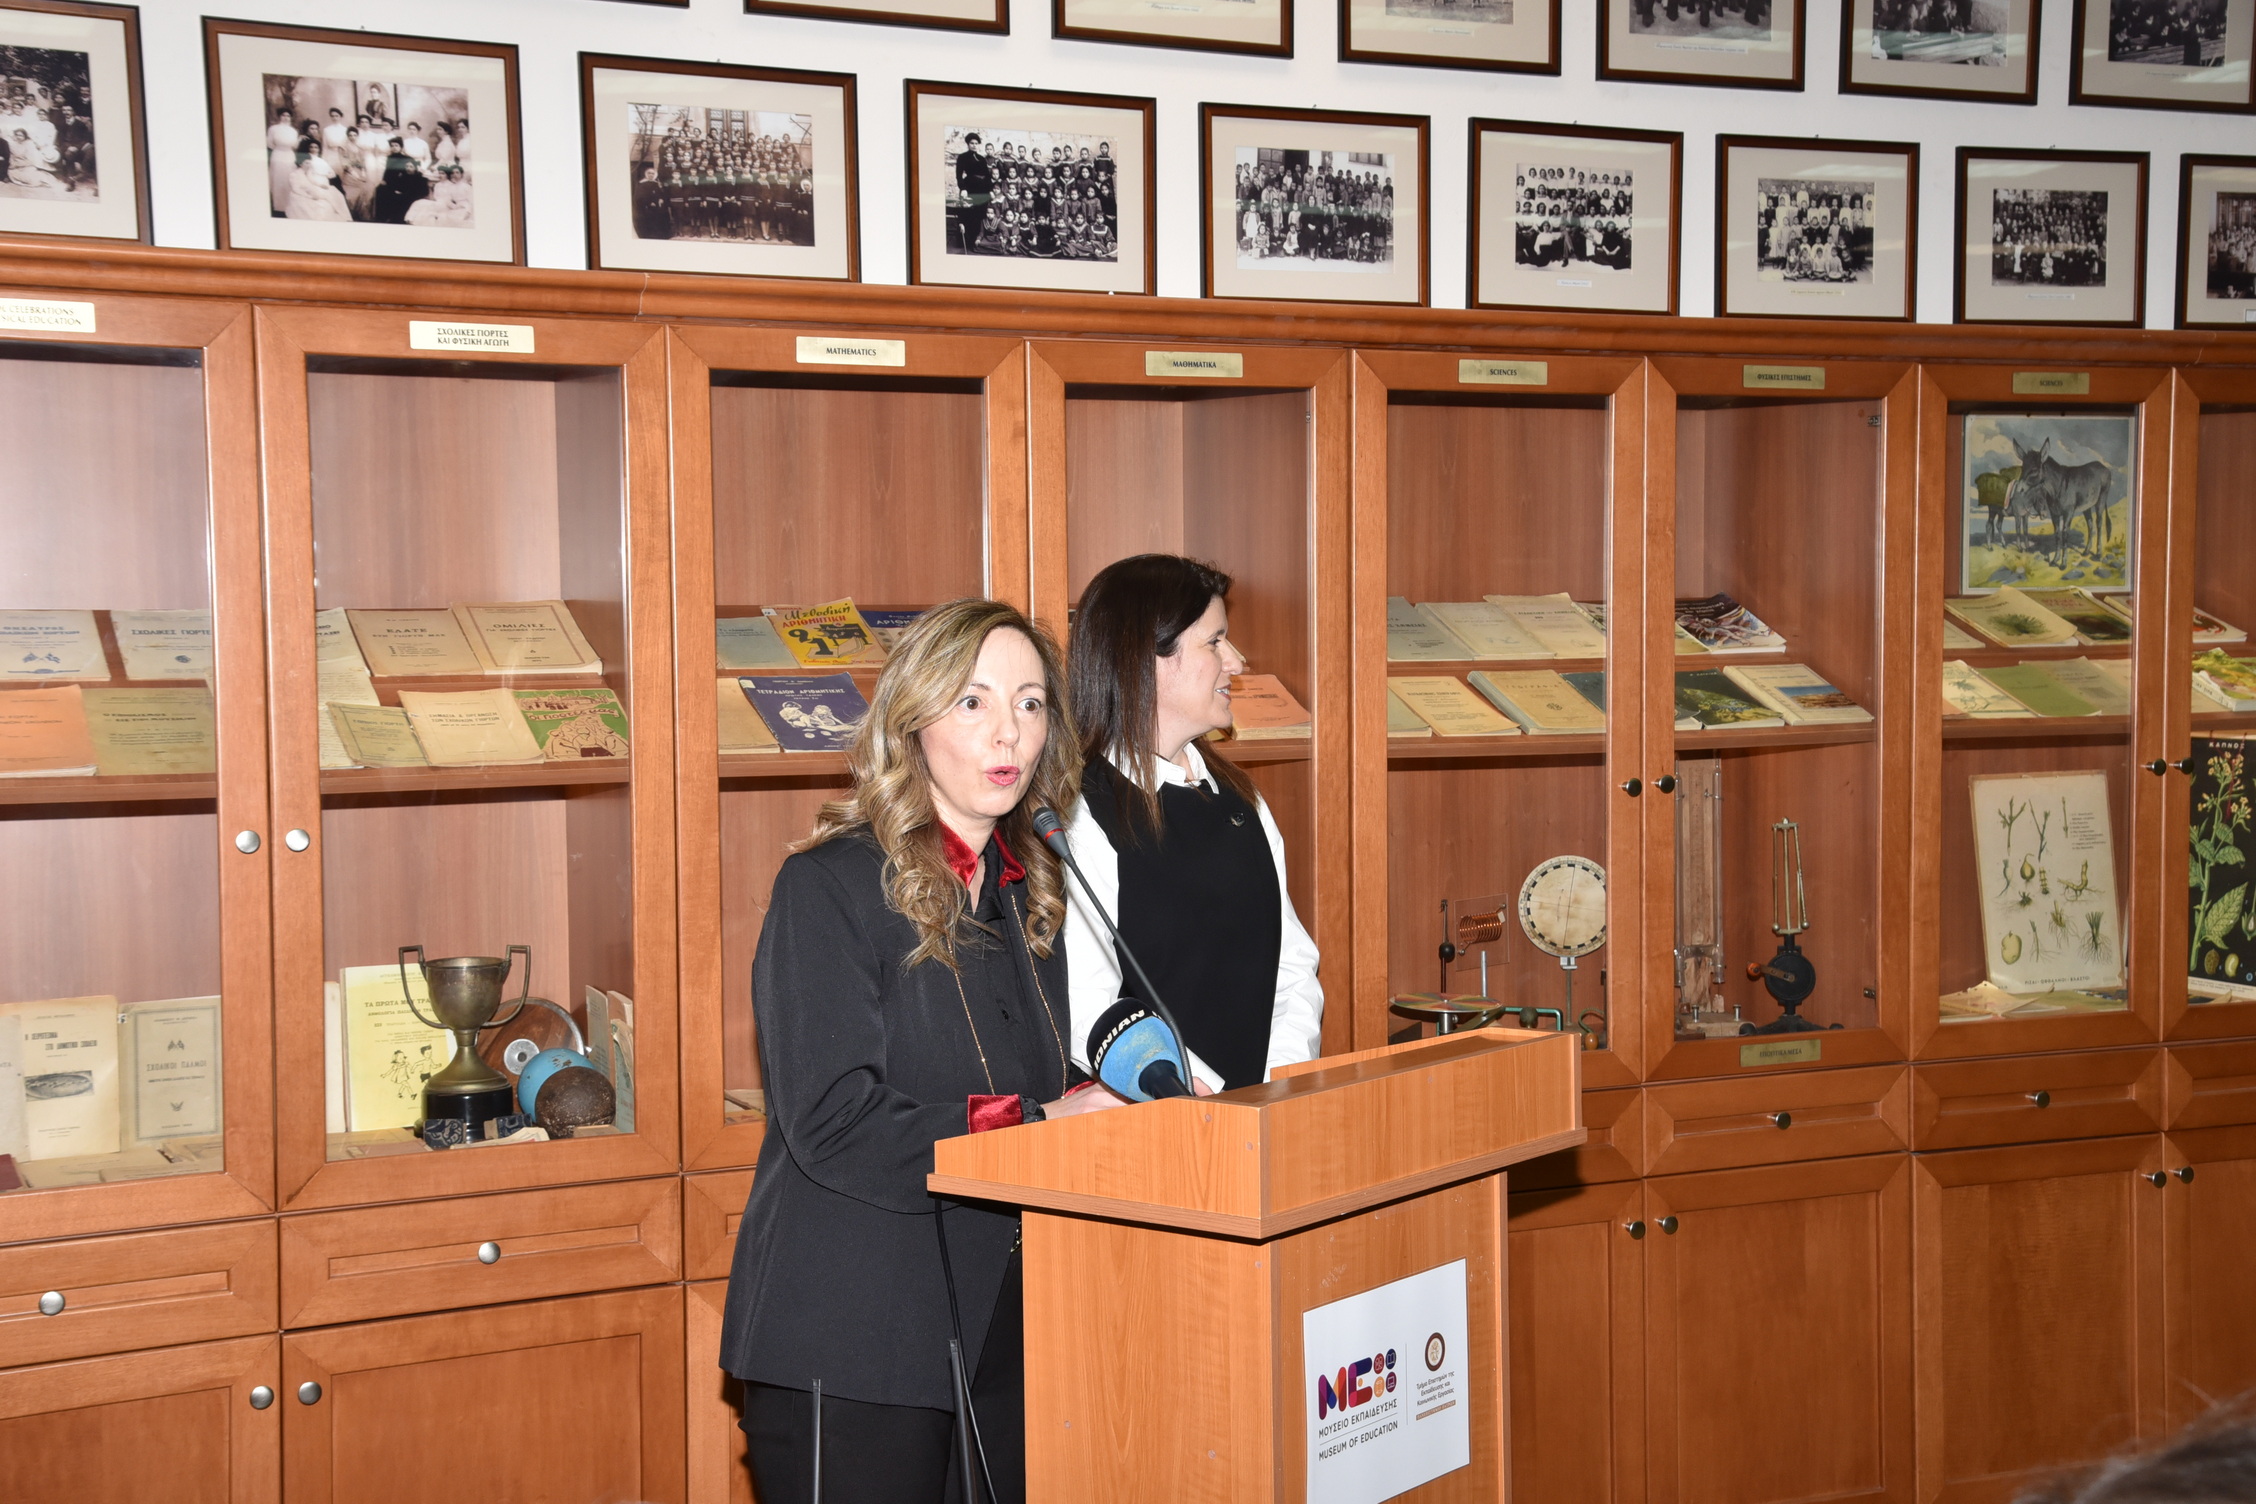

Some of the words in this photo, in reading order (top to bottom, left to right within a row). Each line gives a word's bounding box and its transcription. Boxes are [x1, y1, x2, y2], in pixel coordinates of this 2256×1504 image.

[9, 305, 75, 316] CELEBRATIONS
[29, 315, 82, 326] EDUCATION
[437, 327, 476, 337] ΣΧΟΛΙΚΕΣ
[477, 329, 509, 338] ΓΙΟΡΤΕΣ
[437, 336, 451, 344] ΚΑΙ
[451, 337, 482, 346] ΦΥΣΙΚΗ
[483, 338, 510, 347] ΑΓΩΓΗ
[826, 347, 877, 357] MATHEMATICS
[1172, 360, 1217, 370] ΜΑΘΗΜΑΤΙΚΑ
[1490, 368, 1518, 377] SCIENCES
[782, 615, 847, 629] ΑΡΙΘΜΗΤΙΚΗ
[756, 688, 796, 696] ΤΕΤΡΑΔΙΟΝ
[799, 687, 846, 695] ΑΡΙΘΜΗΤΙΚΗΣ
[2208, 741, 2246, 750] ΚΑΠΝΟΣ
[1093, 1009, 1145, 1071] IONIAN
[1318, 1417, 1349, 1439] ΜΟΥΣΕΙΟ
[1351, 1398, 1398, 1425] ΕΚΠΑΙΔΕΥΣΗΣ
[1318, 1442, 1347, 1462] MUSEUM
[1349, 1437, 1359, 1448] OF
[1360, 1419, 1399, 1444] EDUCATION
